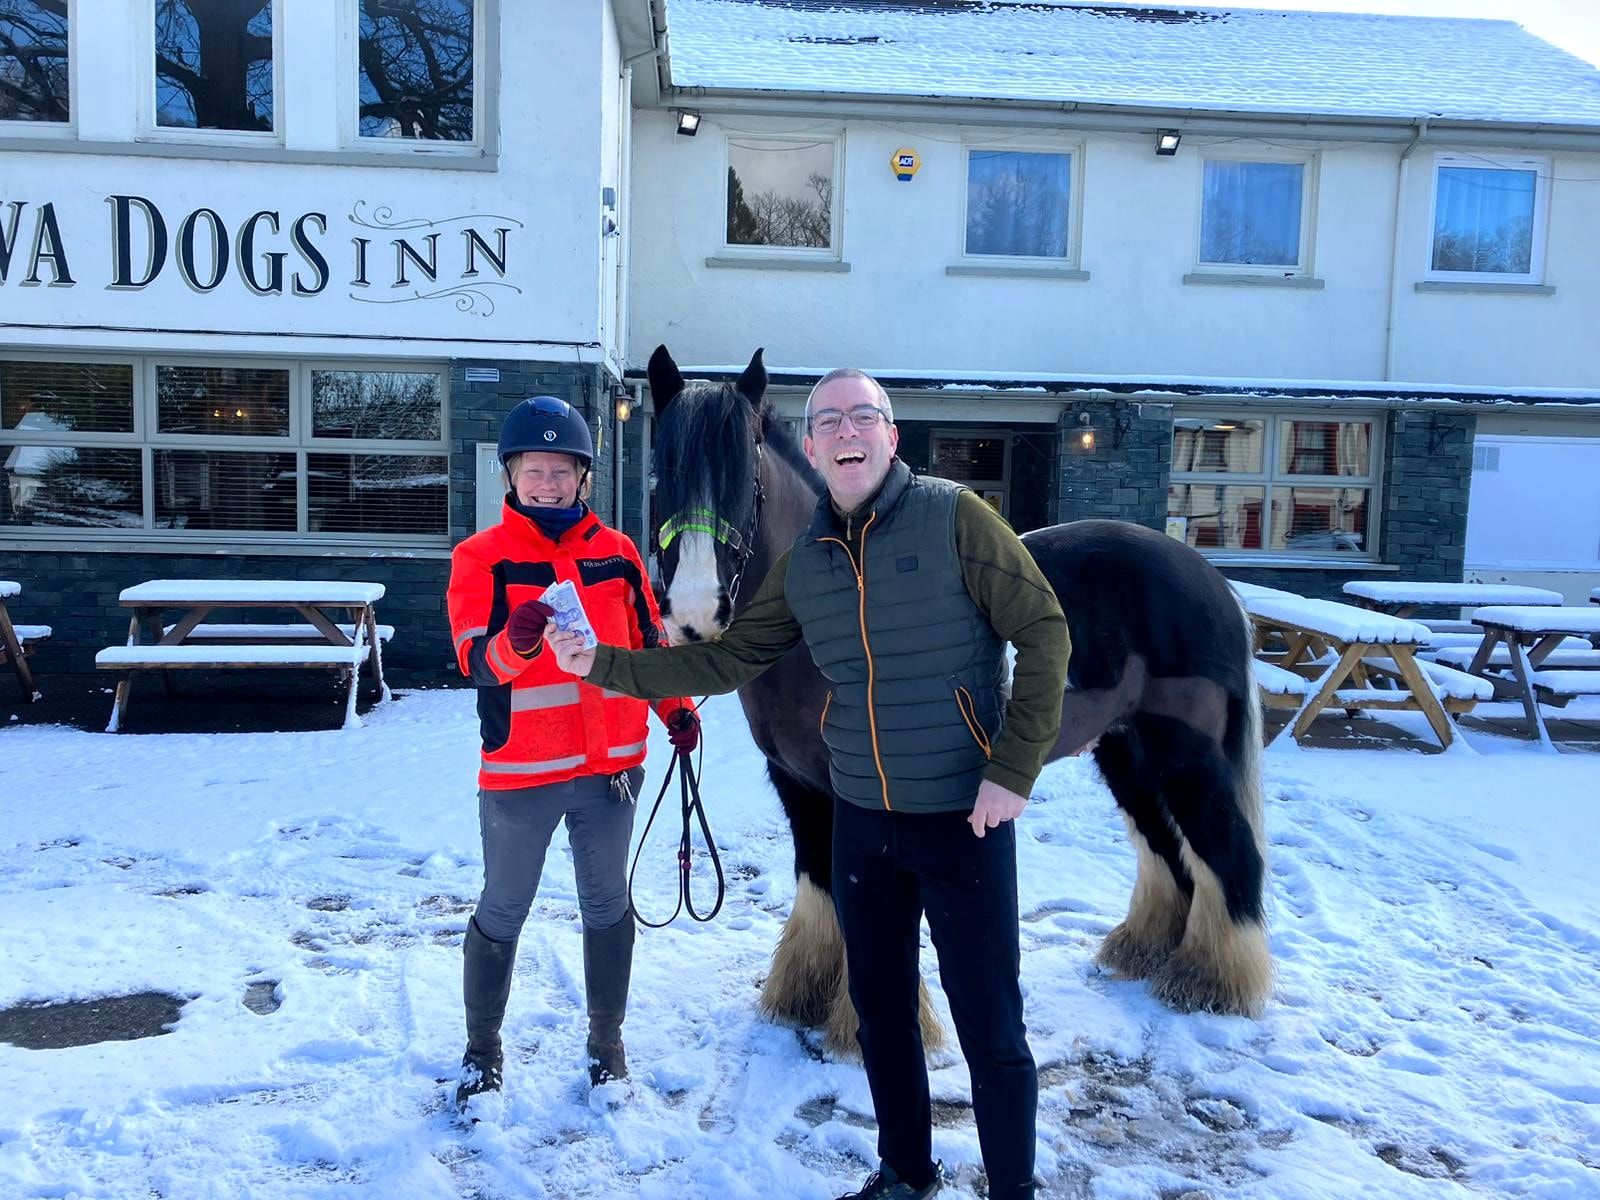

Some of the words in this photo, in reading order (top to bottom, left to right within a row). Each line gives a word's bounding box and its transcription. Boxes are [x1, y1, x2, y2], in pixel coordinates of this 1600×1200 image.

[899, 156, 914, 166] ADT
[104, 195, 330, 297] DOGS
[350, 228, 511, 288] INN
